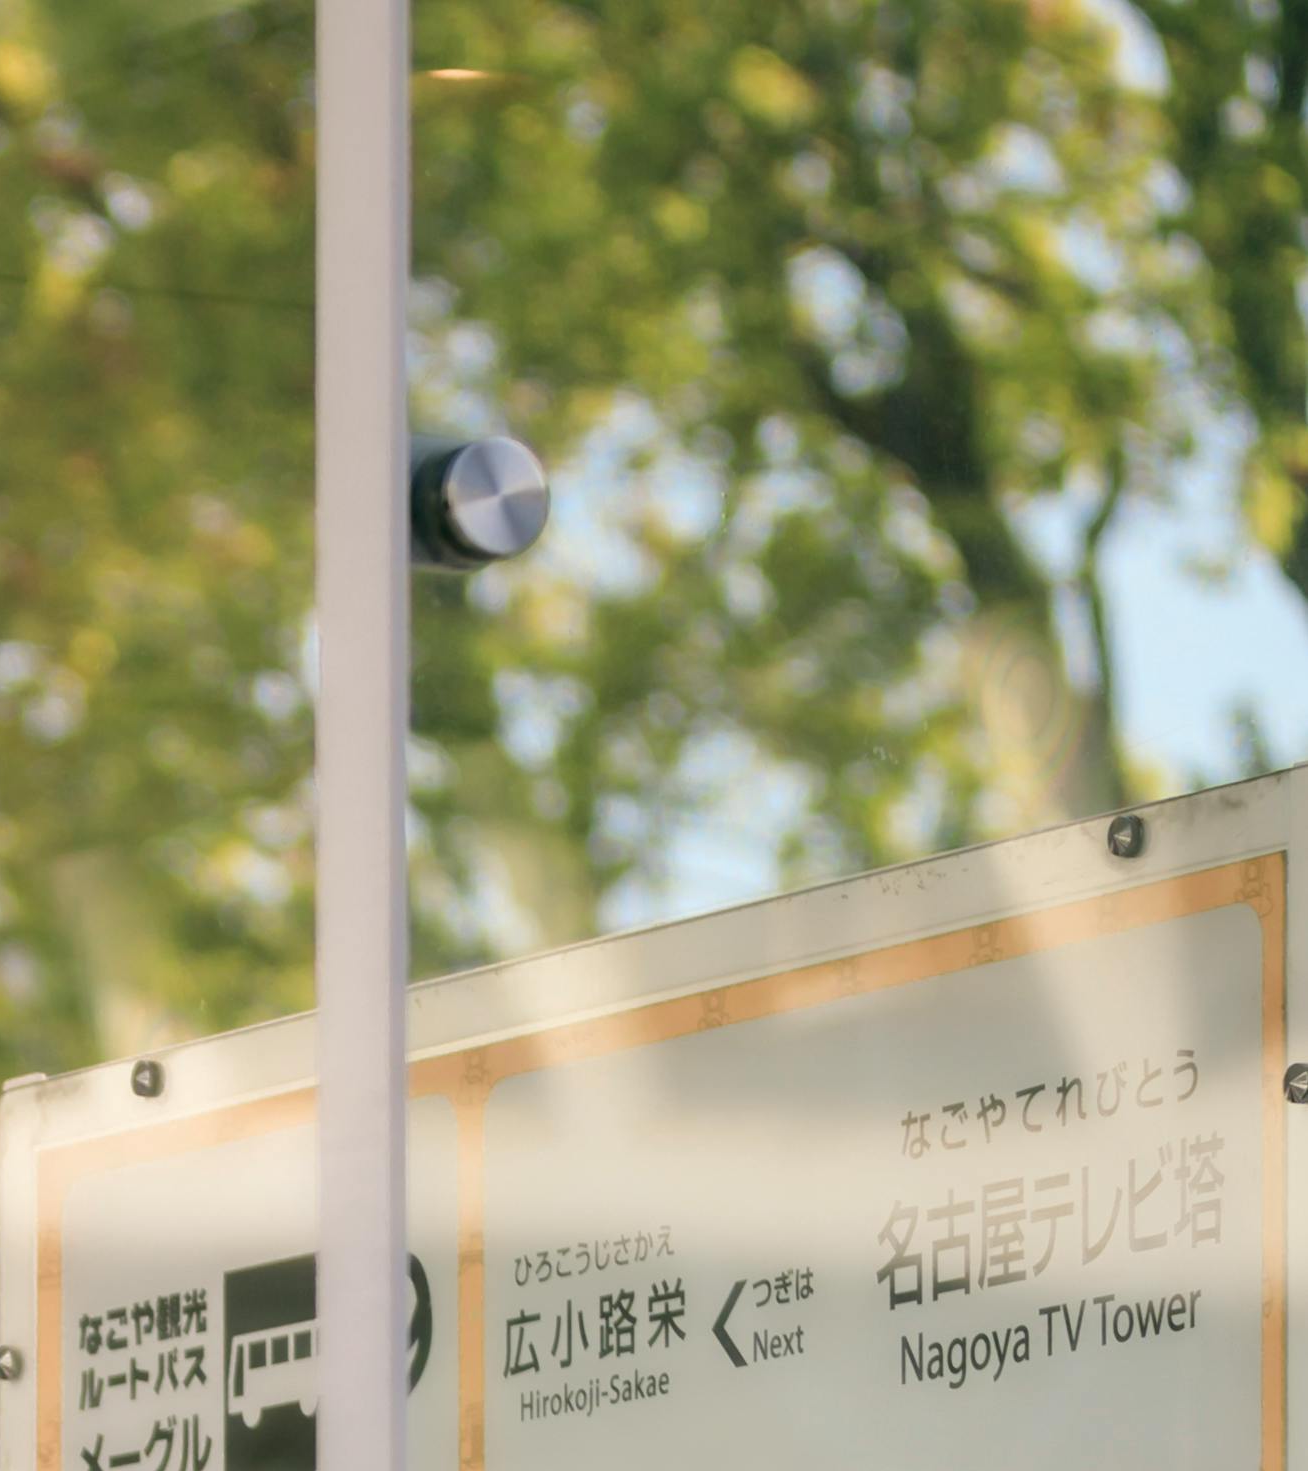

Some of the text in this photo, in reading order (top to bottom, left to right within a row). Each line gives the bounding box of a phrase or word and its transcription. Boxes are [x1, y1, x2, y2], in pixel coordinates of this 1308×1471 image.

[901, 1049, 1199, 1159] なごやてれびとう
[876, 1132, 1224, 1310] 名古屋テレビ塔
[514, 1225, 675, 1287] ひろこうじさかえ
[752, 1267, 814, 1308] つぎは
[79, 1289, 208, 1355] なごや観光
[503, 1277, 686, 1378] 広小路栄
[753, 1325, 804, 1362] Next
[900, 1289, 1202, 1389] Nagoya TV Tower
[79, 1346, 208, 1410] ルートバス
[521, 1368, 670, 1421] Hirokoji-Sakae
